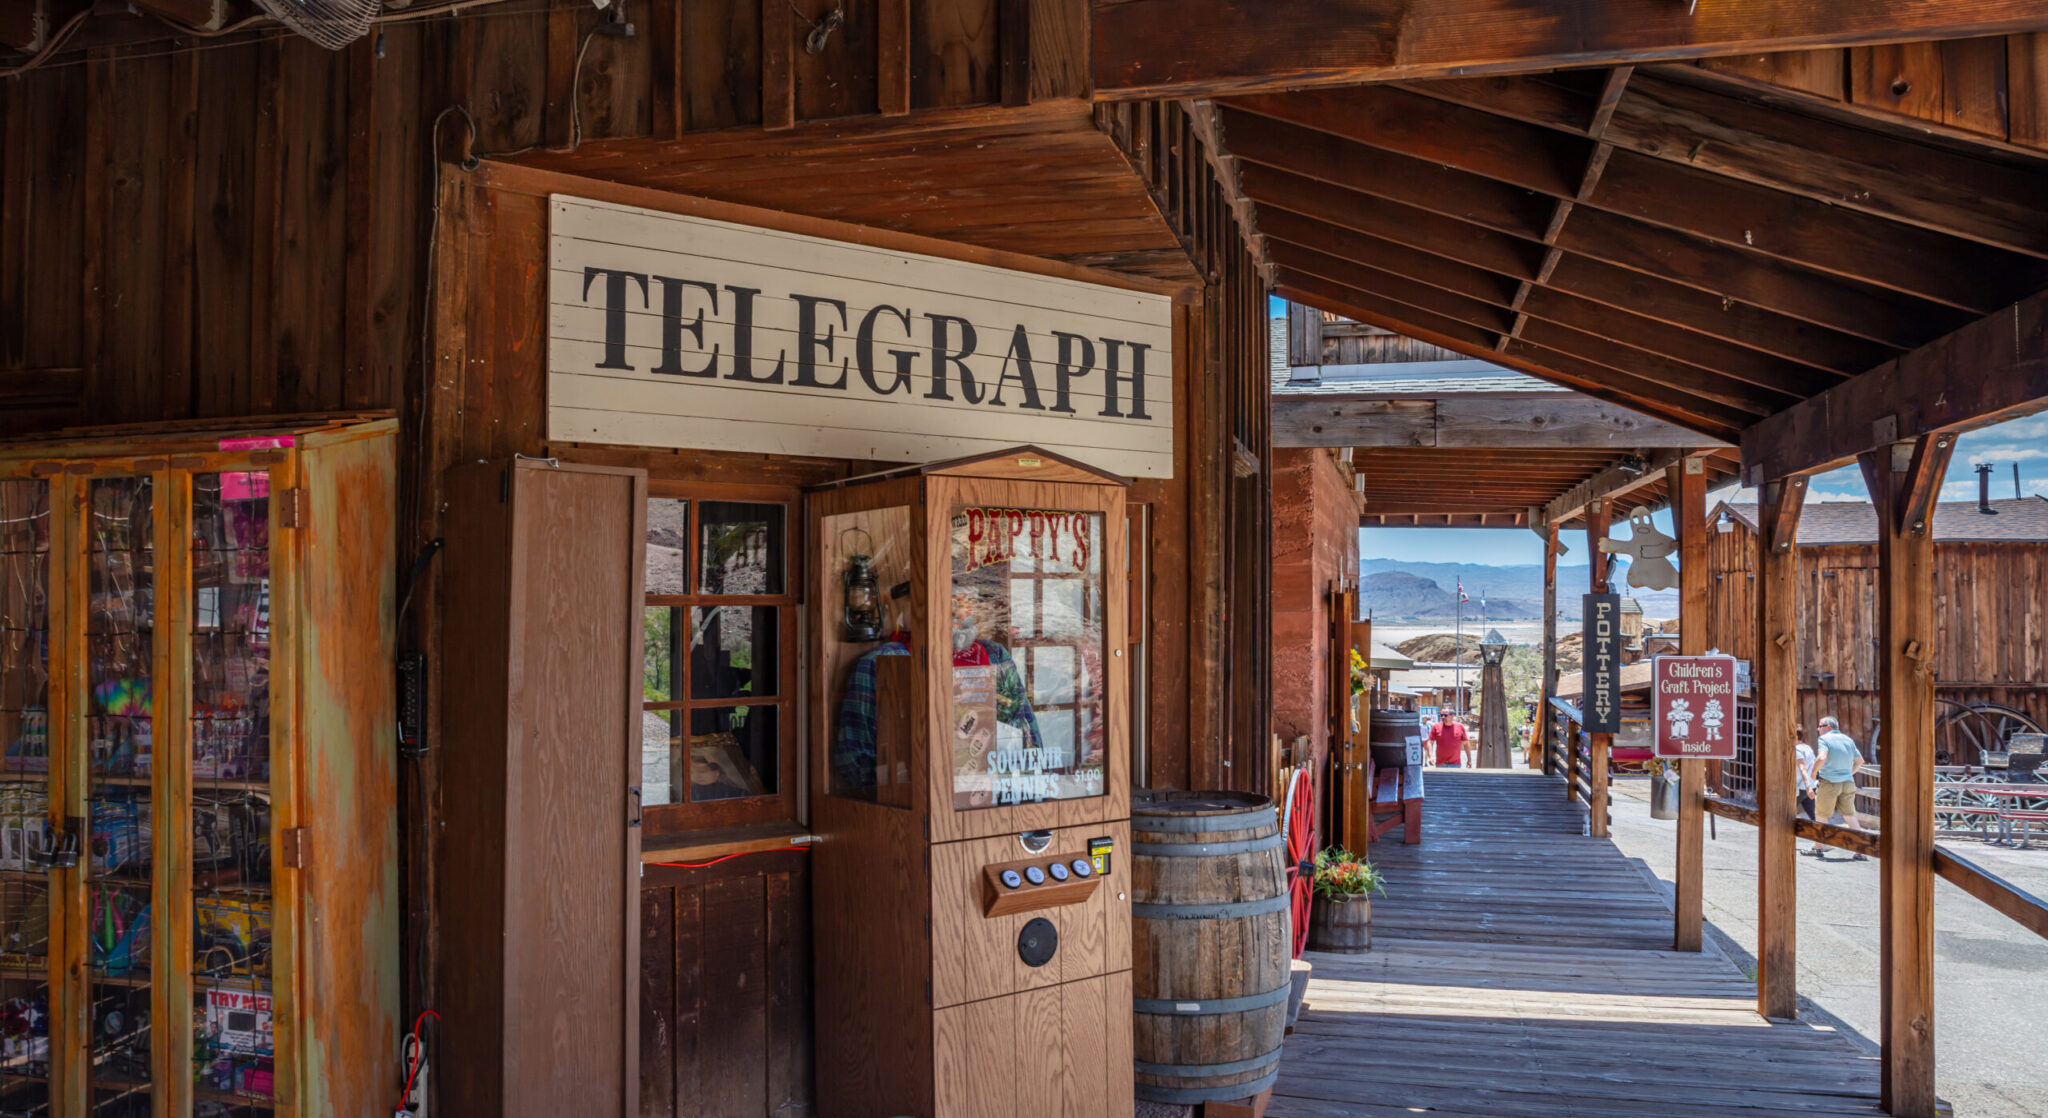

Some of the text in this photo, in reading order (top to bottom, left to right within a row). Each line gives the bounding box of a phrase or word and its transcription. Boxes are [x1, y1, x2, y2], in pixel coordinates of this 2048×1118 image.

[582, 266, 1153, 420] TELEGRAPH
[965, 507, 1088, 574] PAPPY'S
[1595, 602, 1612, 724] POTTERY
[1669, 662, 1723, 678] Children's
[1661, 679, 1690, 694] Craft
[1691, 679, 1731, 698] Project
[1680, 740, 1712, 753] Inside
[986, 746, 1063, 776] SOUVENIR
[1074, 768, 1101, 783] $1.00
[991, 773, 1060, 804] PENNIES
[208, 991, 240, 1008] TRY
